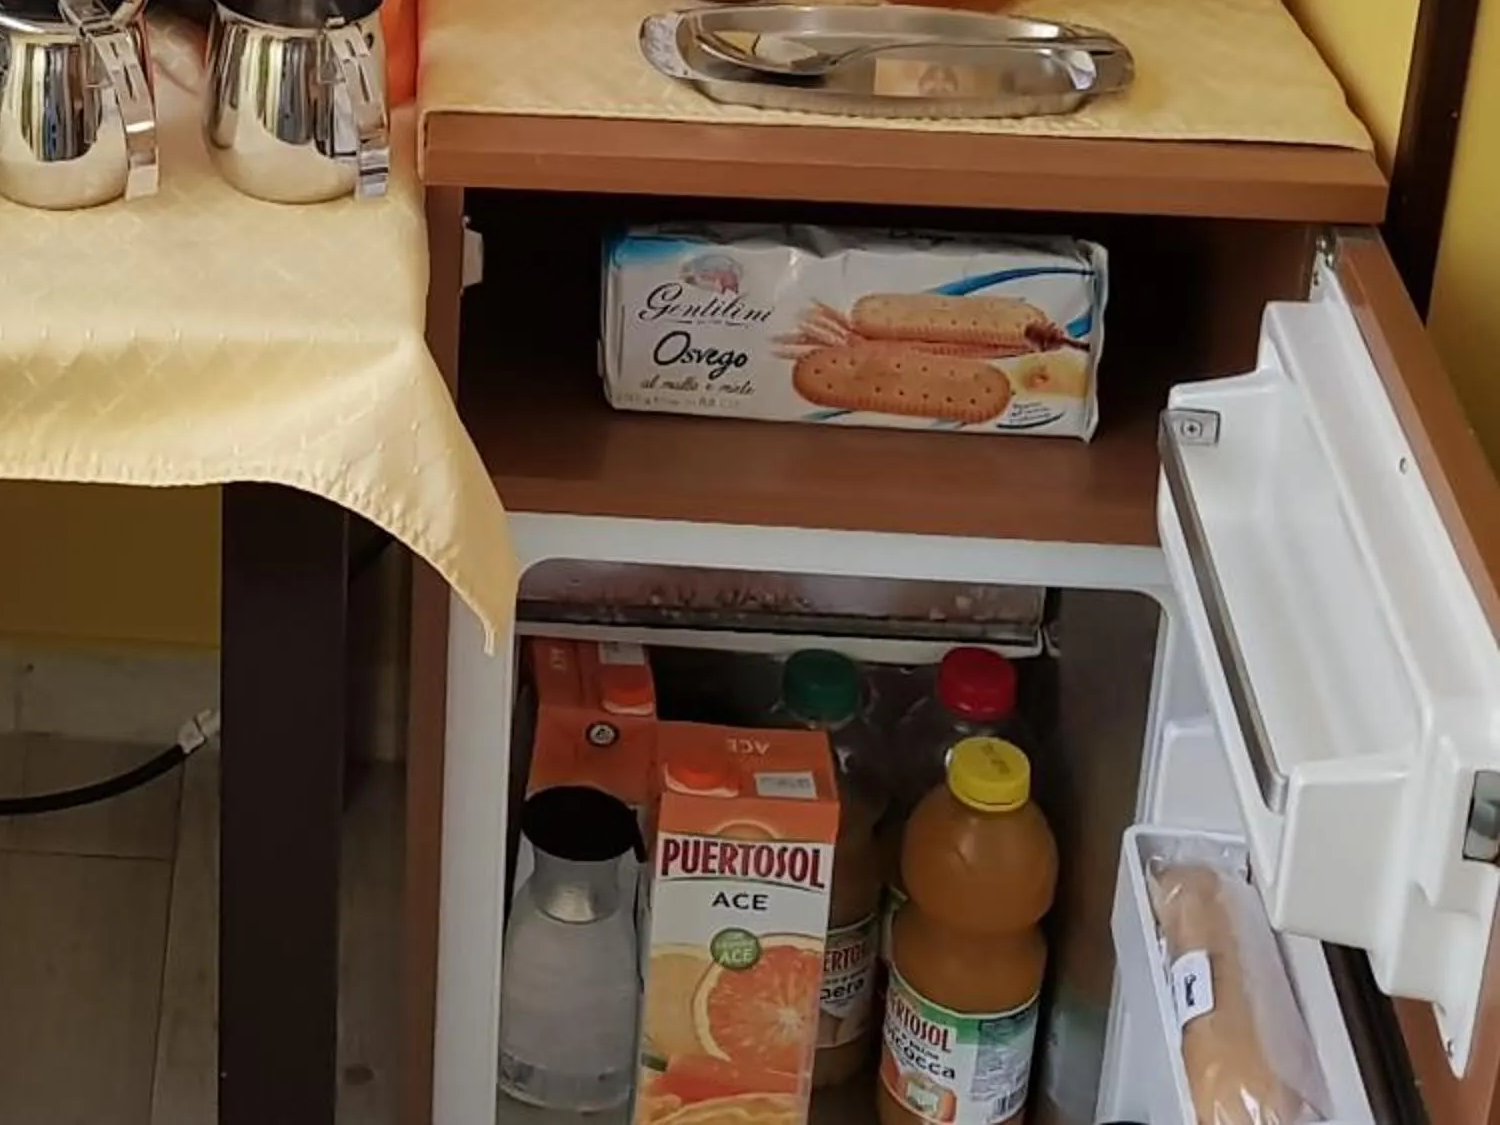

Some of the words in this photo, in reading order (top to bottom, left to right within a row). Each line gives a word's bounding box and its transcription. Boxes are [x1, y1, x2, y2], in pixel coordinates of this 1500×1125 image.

[653, 330, 749, 380] Osvego
[661, 838, 826, 889] PUERTOSOL
[712, 891, 769, 910] ACE
[719, 948, 754, 964] ACE
